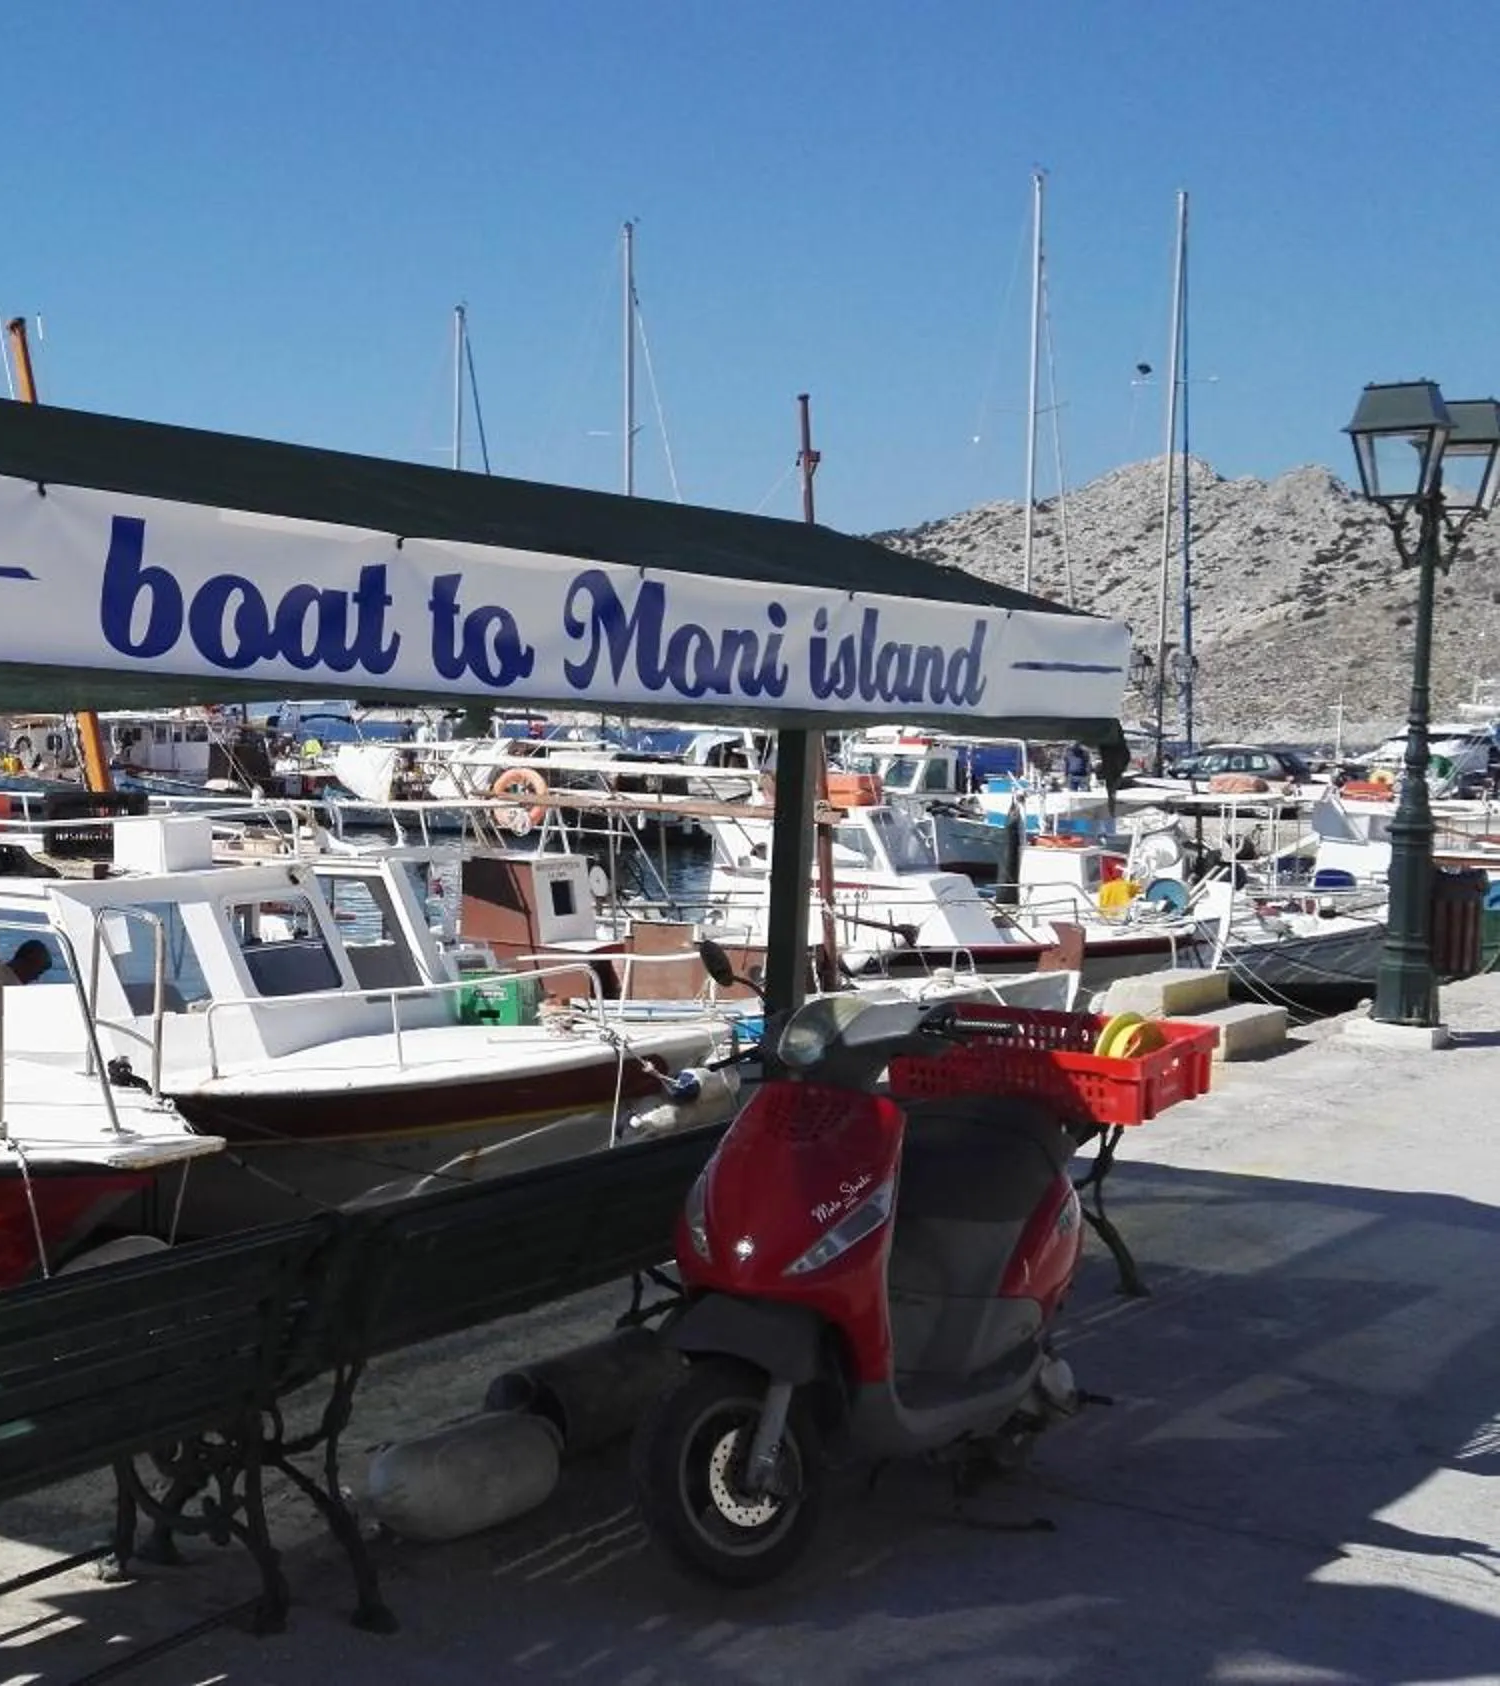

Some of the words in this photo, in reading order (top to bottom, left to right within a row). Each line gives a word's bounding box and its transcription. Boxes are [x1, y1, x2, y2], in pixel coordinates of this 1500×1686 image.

[101, 515, 400, 674] boat
[428, 573, 534, 687] to
[563, 569, 788, 698] Moni
[809, 606, 987, 707] island
